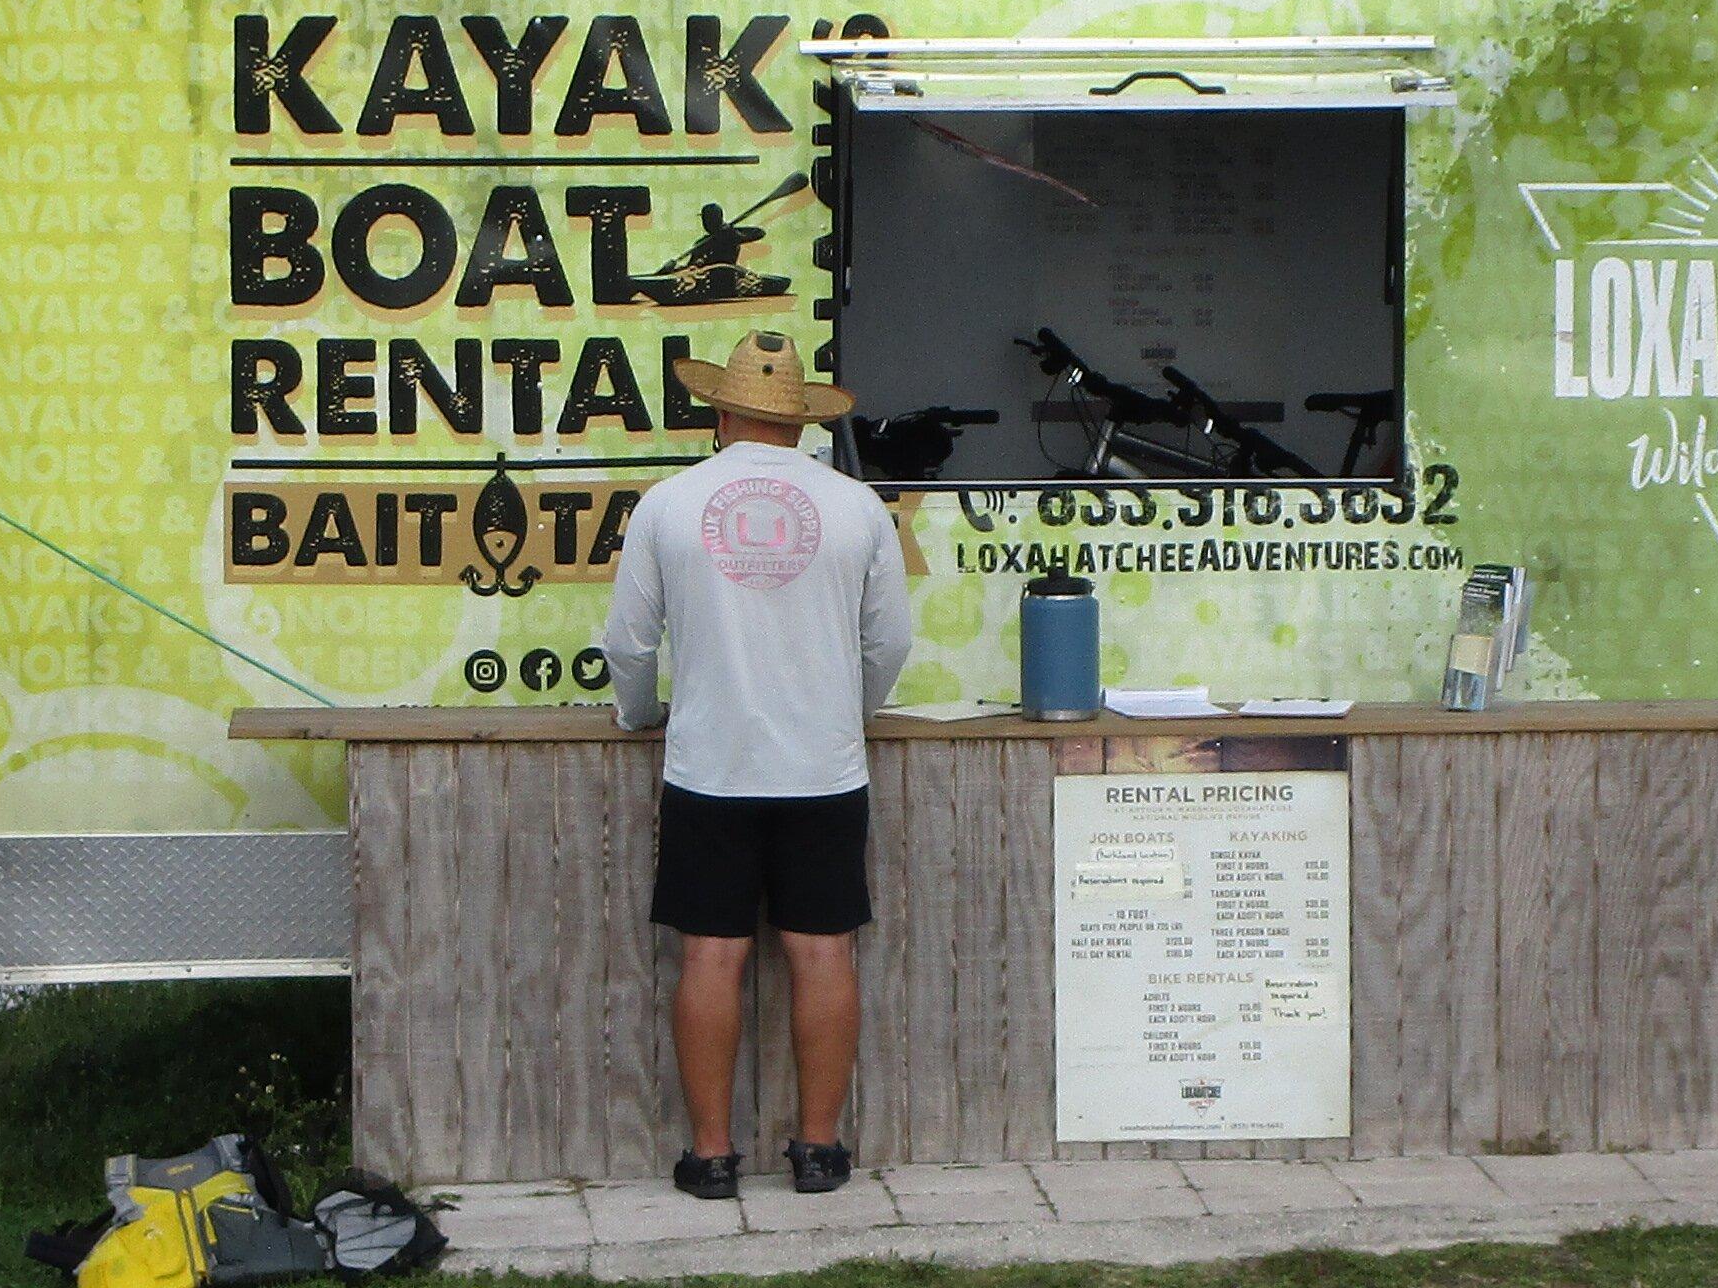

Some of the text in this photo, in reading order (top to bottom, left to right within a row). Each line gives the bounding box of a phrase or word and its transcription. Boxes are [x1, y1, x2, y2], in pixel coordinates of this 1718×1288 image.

[231, 182, 652, 308] BOAT
[711, 479, 784, 510] FISHING
[231, 493, 458, 567] BAIT
[1106, 785, 1294, 803] RENTAL PRICING
[1089, 832, 1175, 844] JON BOATS
[1229, 830, 1307, 842] KAYAKING
[1148, 973, 1254, 984] BIKE RENTALS
